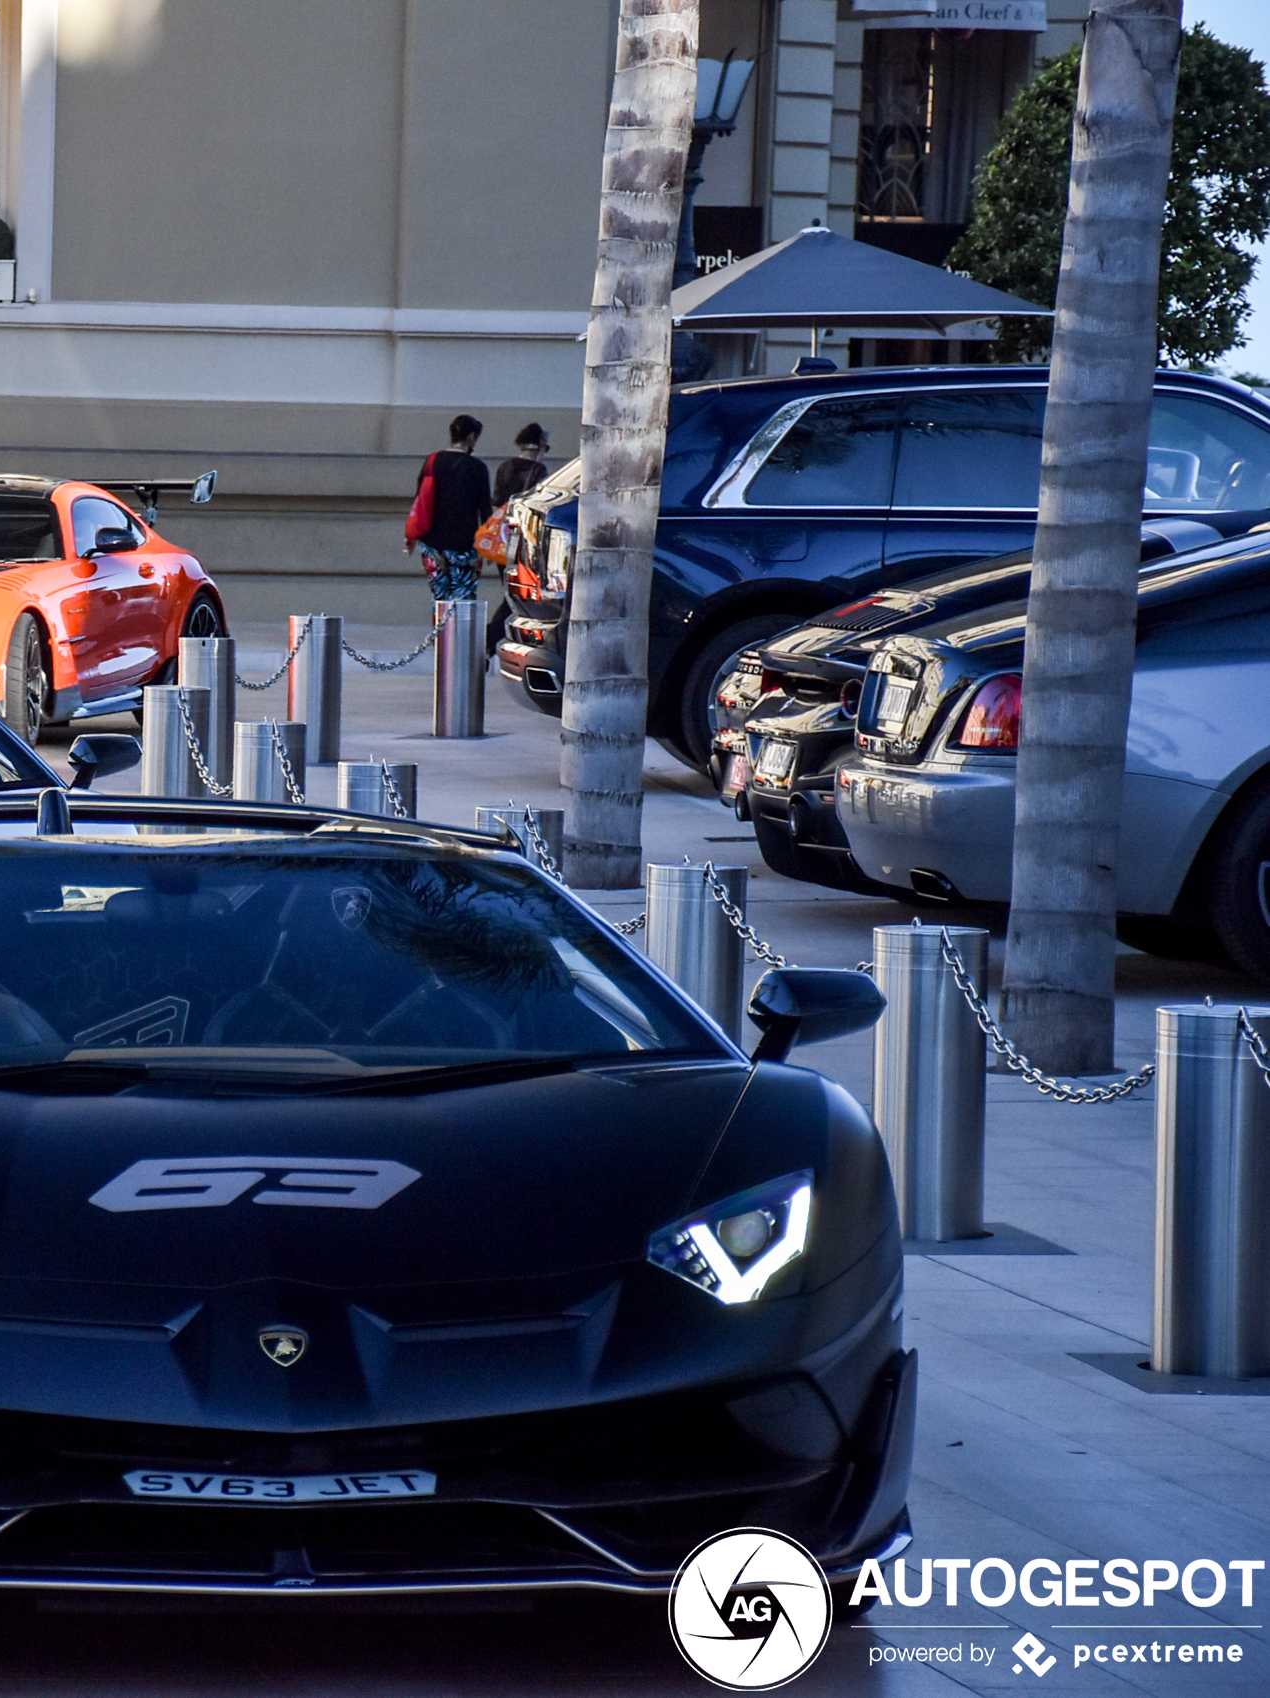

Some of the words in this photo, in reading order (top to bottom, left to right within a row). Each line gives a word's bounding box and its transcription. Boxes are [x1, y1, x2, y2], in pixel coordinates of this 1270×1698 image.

[928, 7, 959, 19] an
[964, 3, 1012, 20] Cleef
[696, 249, 741, 274] rpels
[89, 1156, 422, 1212] 63
[139, 1474, 296, 1498] SV63
[319, 1474, 419, 1496] JET
